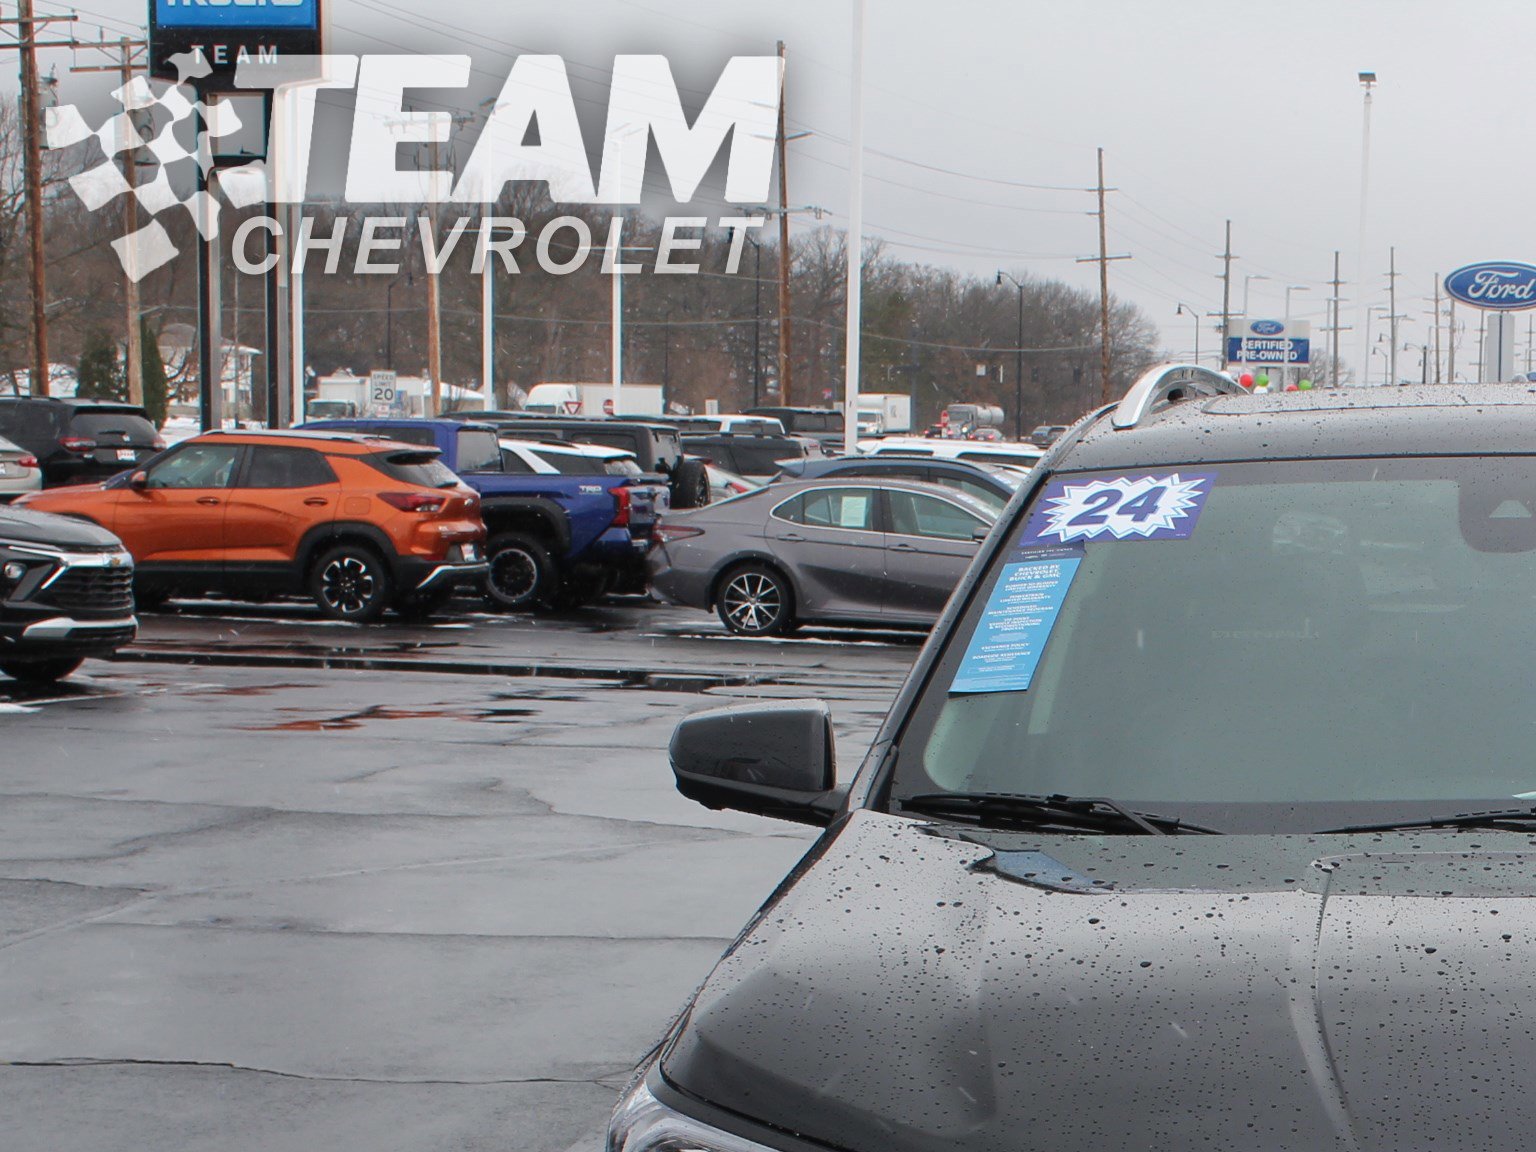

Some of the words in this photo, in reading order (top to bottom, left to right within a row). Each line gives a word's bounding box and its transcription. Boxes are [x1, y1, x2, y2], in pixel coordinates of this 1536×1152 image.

[190, 45, 278, 65] TEAM
[1468, 270, 1536, 299] Ford
[374, 388, 394, 401] 20
[1066, 485, 1171, 527] 24
